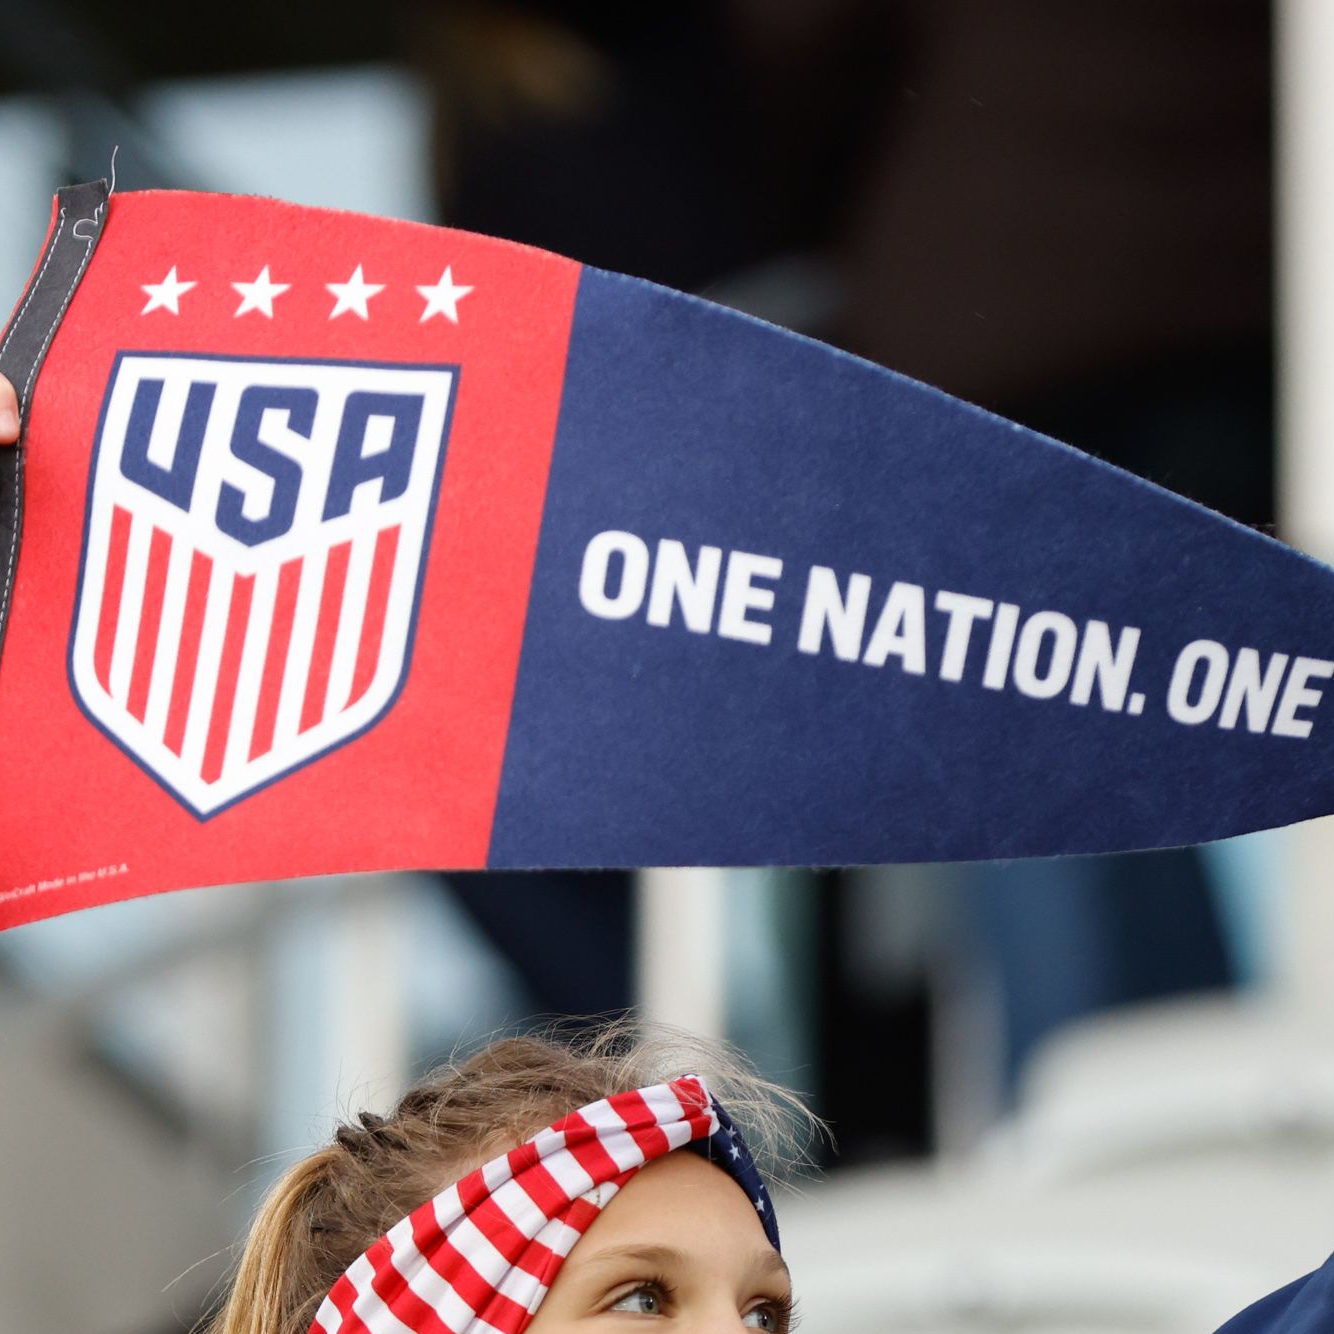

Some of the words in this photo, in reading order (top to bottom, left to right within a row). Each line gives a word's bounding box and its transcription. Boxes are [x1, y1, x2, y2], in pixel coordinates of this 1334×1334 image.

[118, 377, 426, 548] USA
[577, 529, 784, 646] ONE
[796, 564, 1145, 716] NATION.
